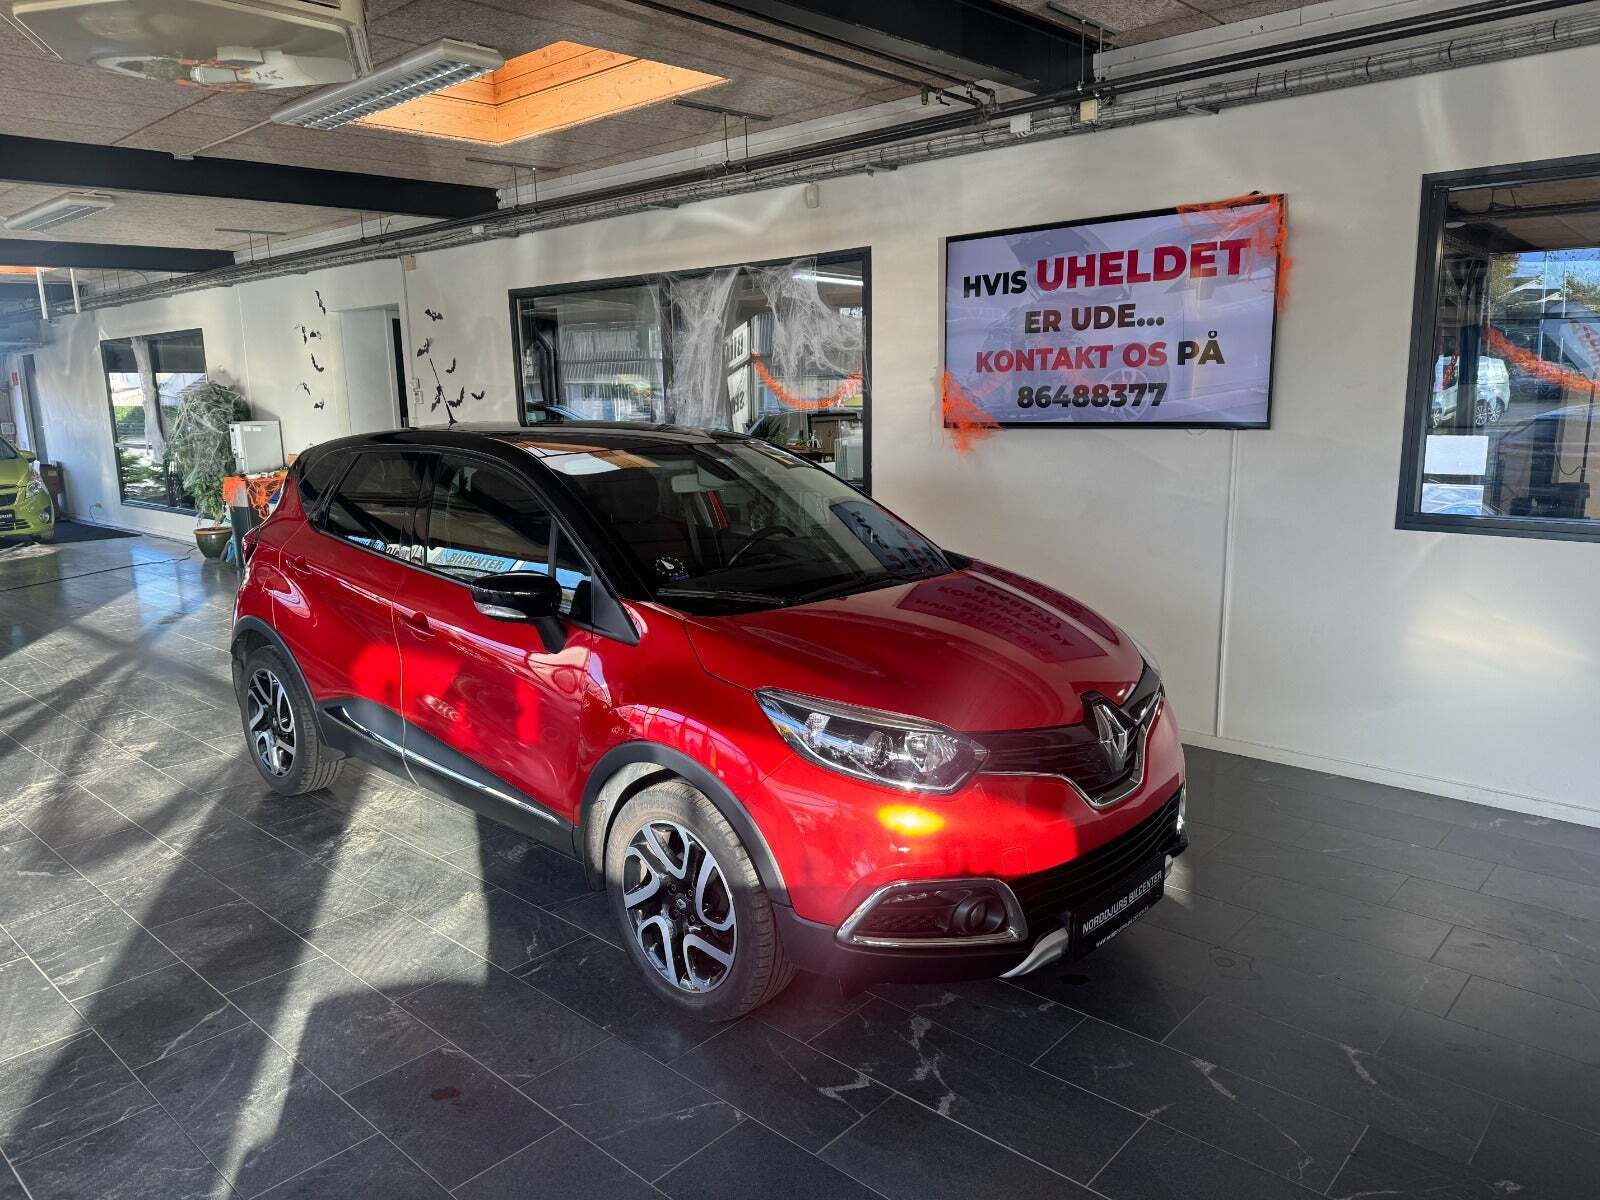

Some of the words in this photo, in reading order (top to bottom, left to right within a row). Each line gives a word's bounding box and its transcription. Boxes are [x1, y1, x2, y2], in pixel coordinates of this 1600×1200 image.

[963, 270, 1028, 298] HVIS
[1036, 238, 1252, 292] UHELDET
[1024, 309, 1062, 334] ER
[1071, 303, 1165, 331] UDE...
[975, 344, 1114, 374] KONTAKT
[1122, 341, 1168, 369] OS
[1177, 330, 1225, 366] PÅ
[1017, 382, 1168, 409] 86488377
[1082, 895, 1128, 935] NORDDJURS
[1128, 870, 1162, 904] BILCENTER
